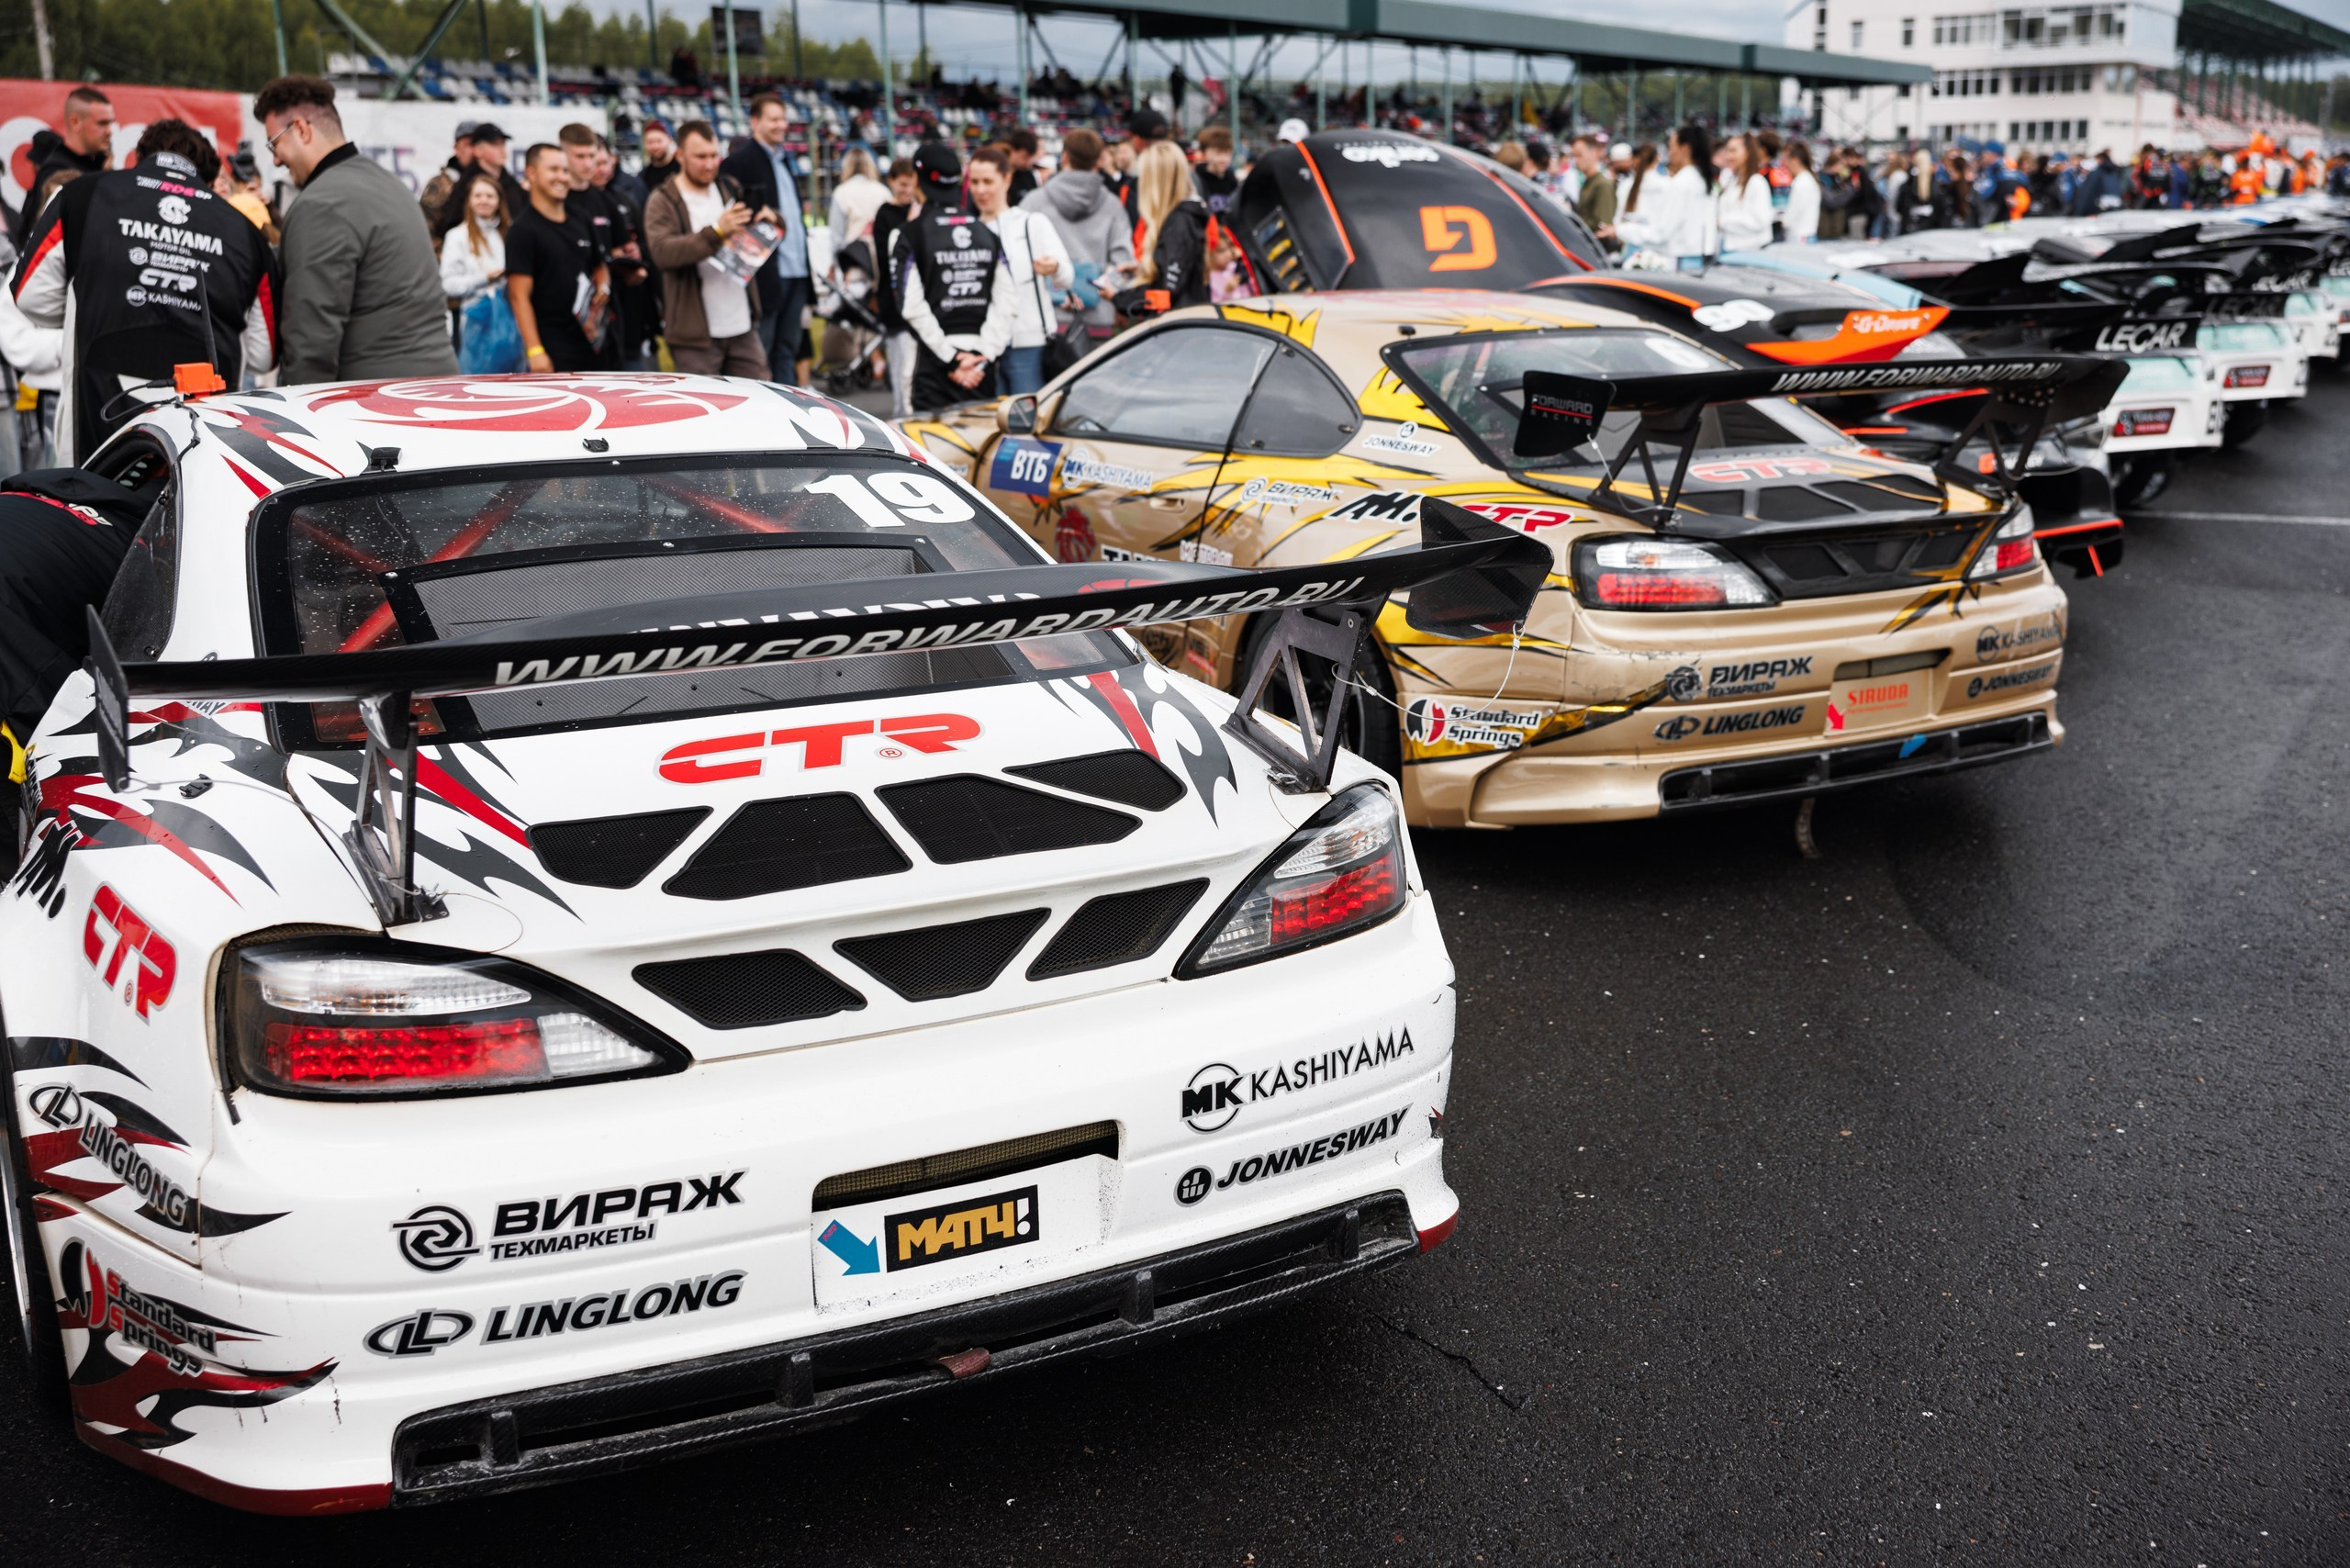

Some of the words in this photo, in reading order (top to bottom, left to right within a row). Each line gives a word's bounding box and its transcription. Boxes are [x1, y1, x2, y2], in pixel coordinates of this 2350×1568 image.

[118, 218, 223, 255] TAKAYAMA
[2095, 322, 2188, 353] LECAR
[1530, 409, 1593, 426] RACING
[1531, 394, 1594, 414] FORWARD
[1364, 436, 1438, 454] JONNESWAY
[1011, 449, 1052, 484] ВТБ
[1086, 462, 1152, 489] KASHIYAMA
[803, 472, 976, 528] 19
[495, 577, 1365, 687] WWW.FORWARDAUTO.RU
[1709, 656, 1814, 685] ВИРАЖ
[1449, 706, 1539, 726] Standard
[1703, 705, 1806, 735] LINGLONG
[1448, 725, 1522, 748] Springs
[1181, 1076, 1245, 1119] MK
[1251, 1026, 1415, 1103] KASHIYAMA
[1217, 1107, 1410, 1189] JONNESWAY
[82, 1112, 186, 1225] LINGLONG
[492, 1170, 746, 1238] ВИРАЖ
[490, 1223, 655, 1260] ТЕХМАРКЕТЫ
[106, 1270, 215, 1353] Standard
[487, 1272, 748, 1342] LINGLONG
[109, 1304, 204, 1373] Springs
